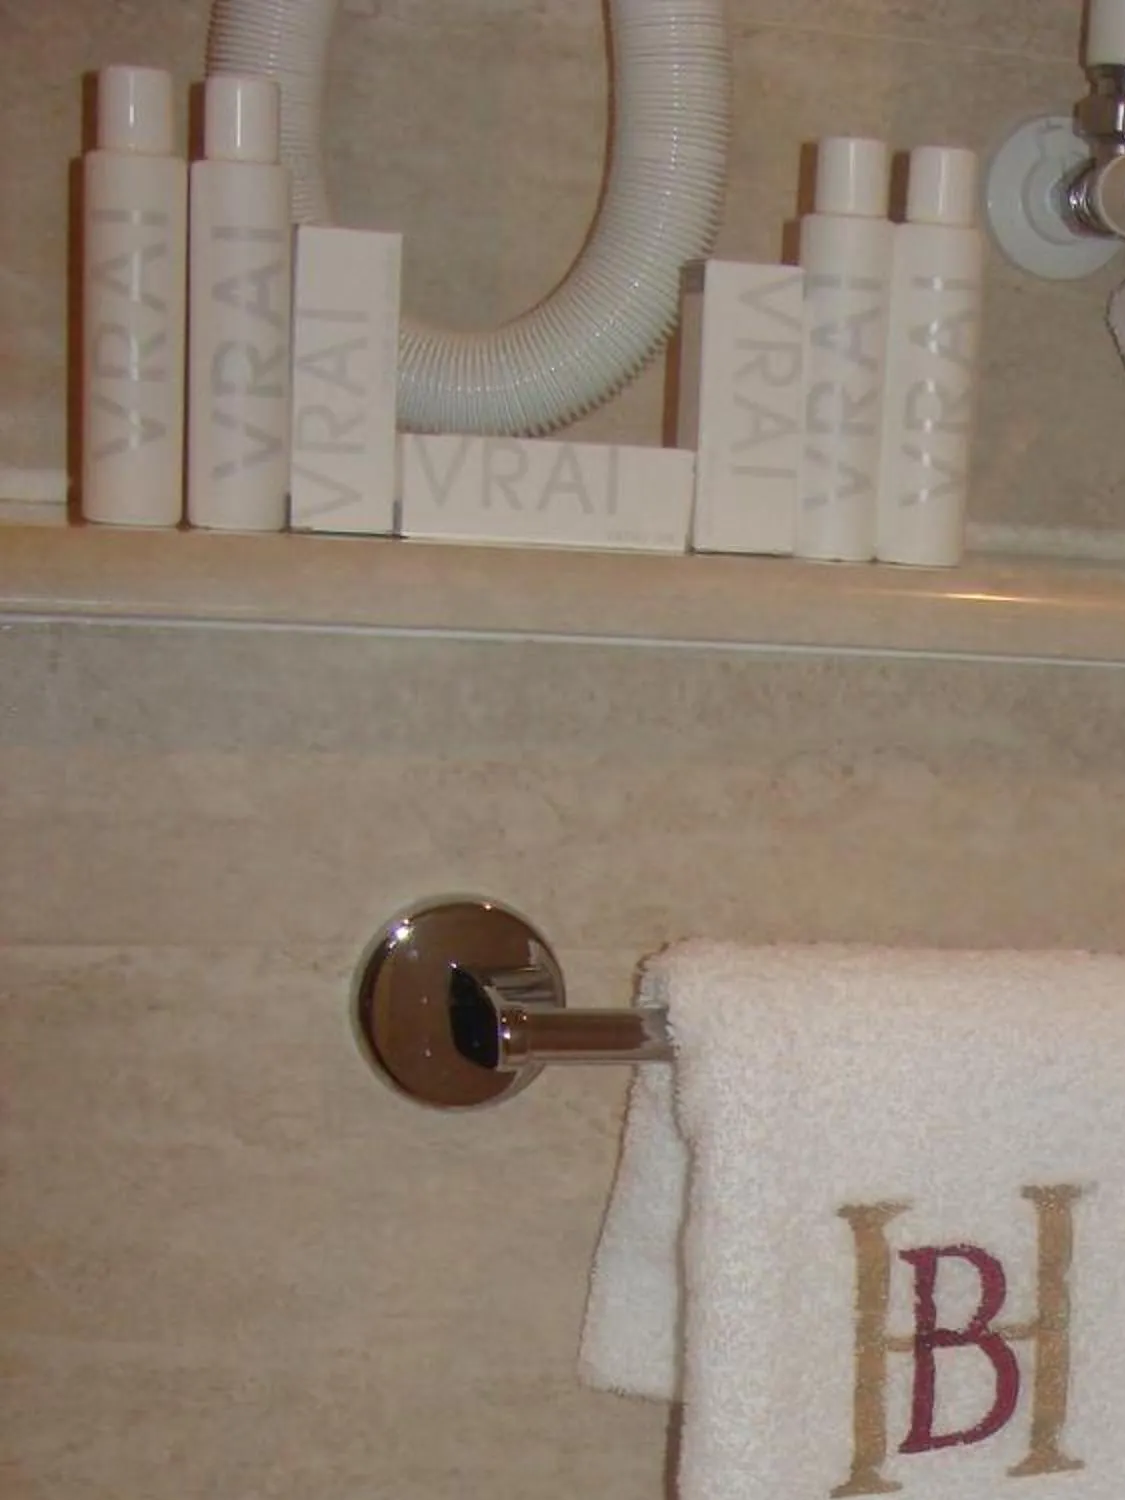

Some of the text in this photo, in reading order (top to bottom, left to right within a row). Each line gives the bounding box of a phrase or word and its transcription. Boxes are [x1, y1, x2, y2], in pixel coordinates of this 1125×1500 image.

[88, 208, 170, 464] VRAI
[209, 225, 286, 482] VRAI
[294, 306, 368, 519] VRAI
[730, 273, 804, 480] VRAI
[802, 274, 884, 512] VRAI
[898, 276, 977, 508] VRAI
[415, 435, 620, 517] VRAI
